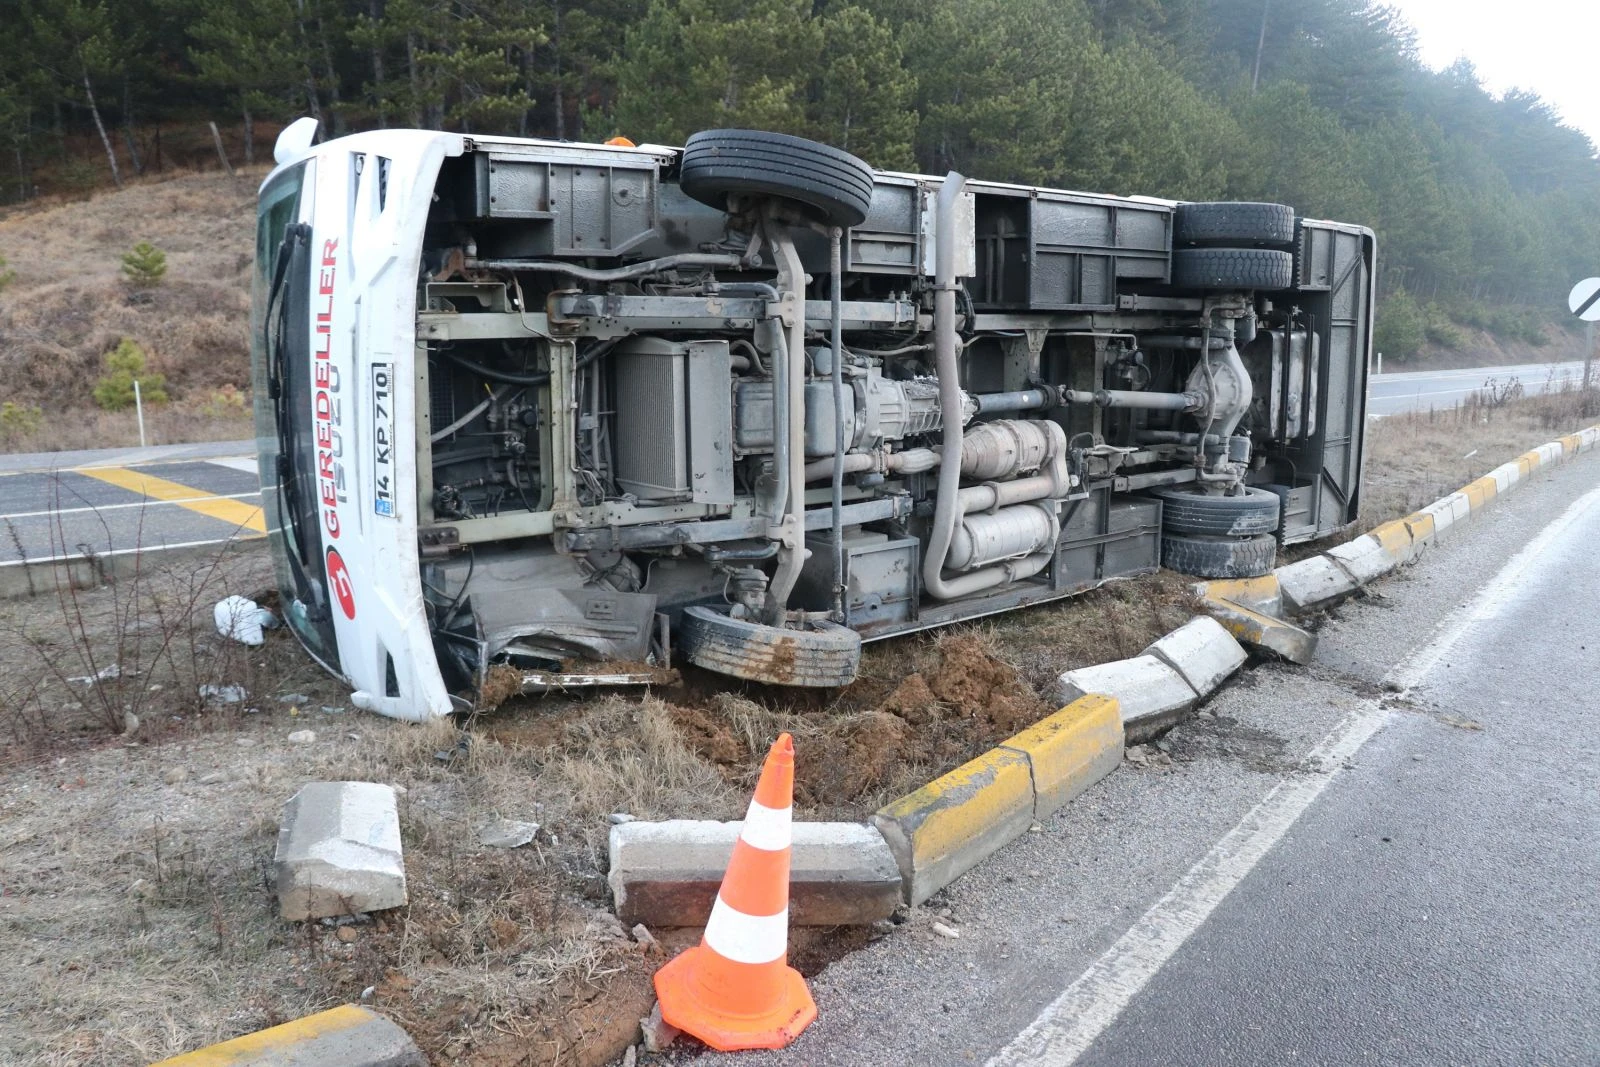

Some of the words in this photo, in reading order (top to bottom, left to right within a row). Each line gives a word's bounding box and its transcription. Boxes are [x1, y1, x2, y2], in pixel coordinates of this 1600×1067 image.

[375, 372, 388, 419] 710
[330, 365, 347, 503] ISUZU
[377, 427, 389, 464] KP
[377, 475, 390, 500] 14
